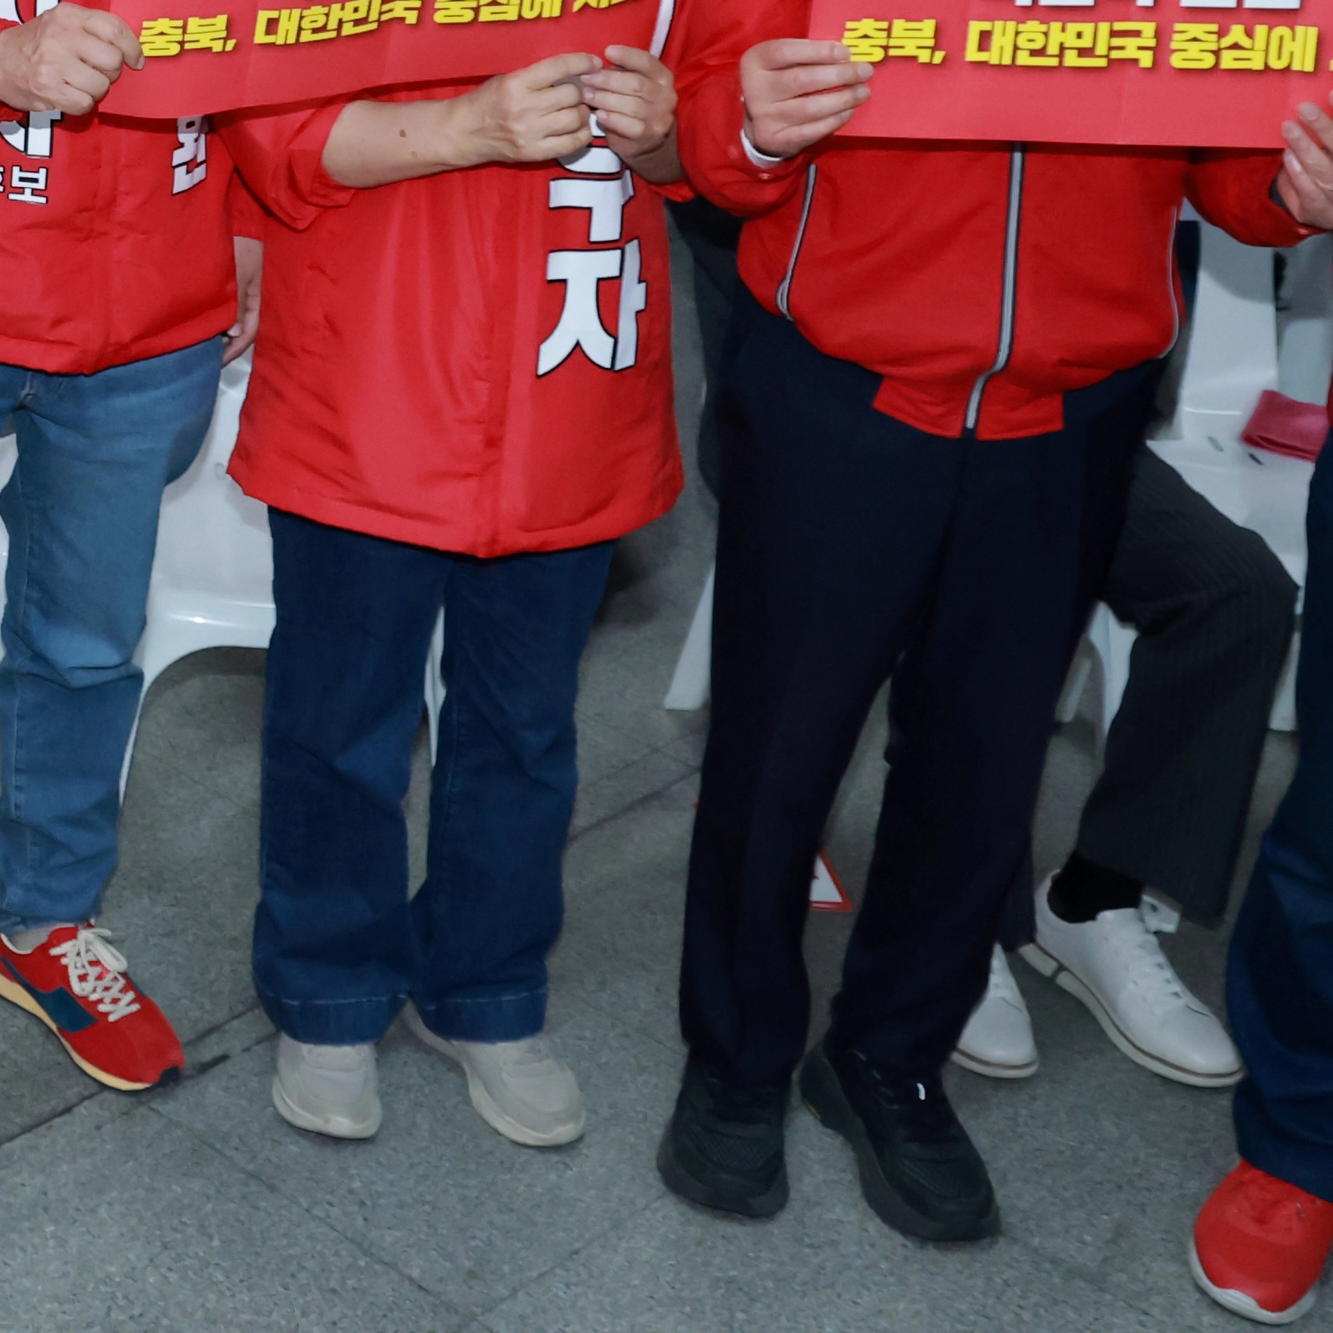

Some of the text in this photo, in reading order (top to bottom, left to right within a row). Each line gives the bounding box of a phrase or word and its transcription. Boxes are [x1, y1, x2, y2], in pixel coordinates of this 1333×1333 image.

[137, 14, 239, 58] 충북,
[840, 17, 1320, 73] 충북, 대한민국 중심에
